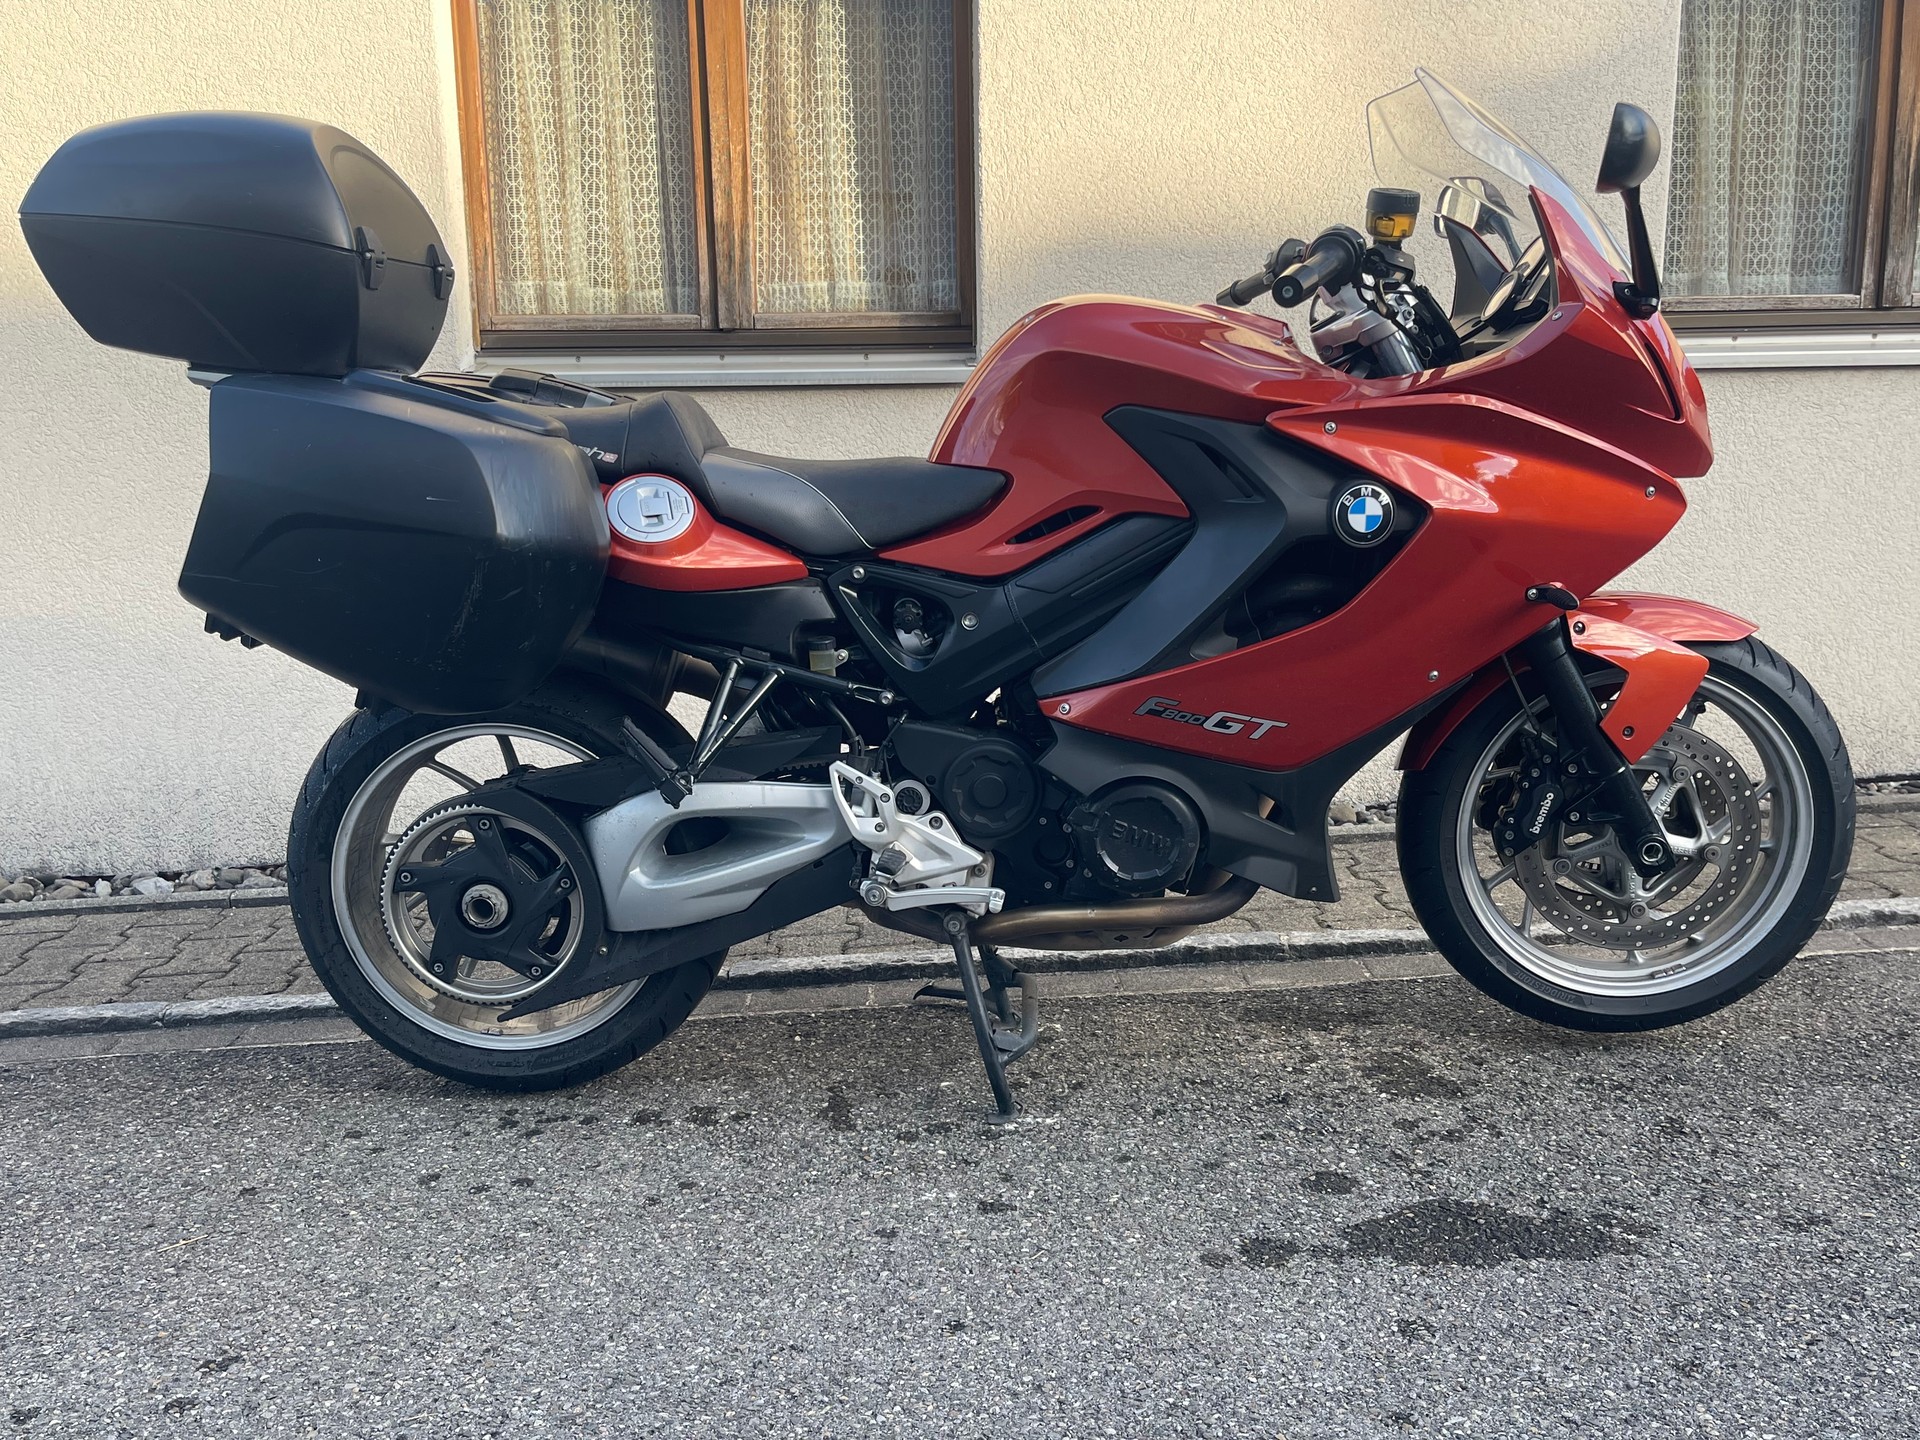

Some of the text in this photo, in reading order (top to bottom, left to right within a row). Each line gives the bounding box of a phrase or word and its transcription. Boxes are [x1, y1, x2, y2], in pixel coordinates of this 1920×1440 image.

[1342, 487, 1389, 506] BMW
[1529, 792, 1554, 834] brembo
[1112, 819, 1173, 857] BMW
[1513, 968, 1577, 1004] BRIDGESTONE
